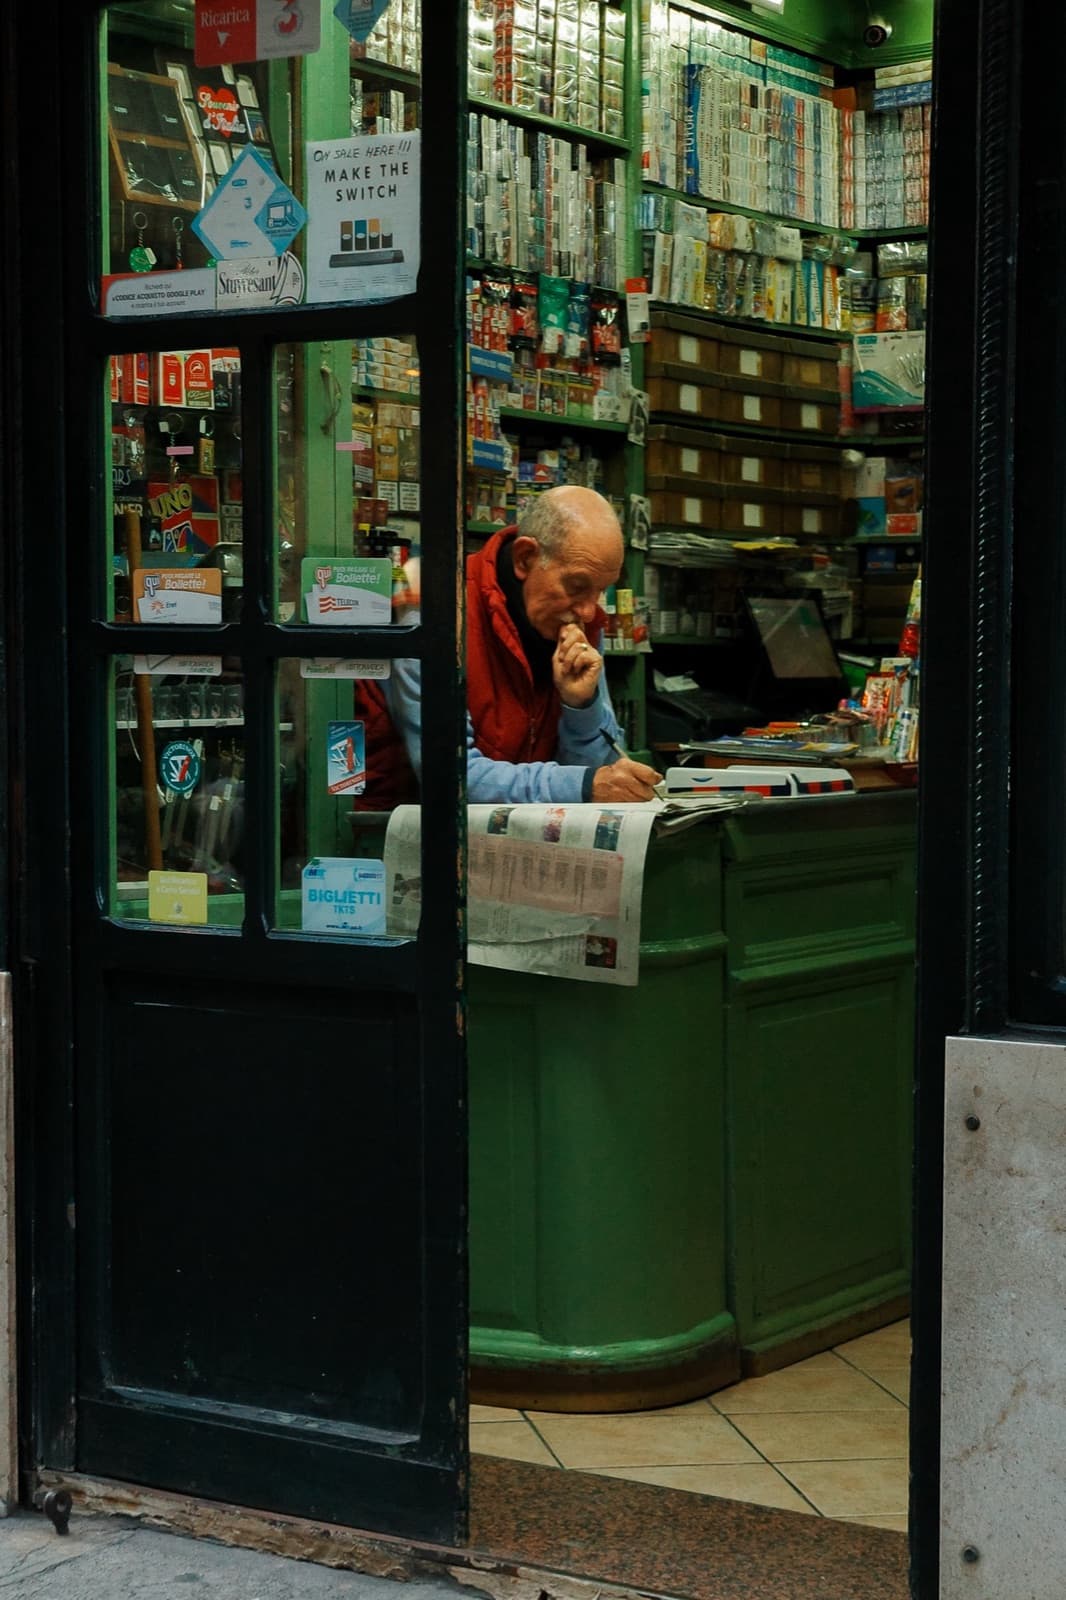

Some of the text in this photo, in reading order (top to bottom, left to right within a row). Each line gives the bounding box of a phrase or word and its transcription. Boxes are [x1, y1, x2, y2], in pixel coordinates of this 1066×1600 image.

[200, 6, 250, 28] Ricarica
[333, 148, 360, 160] SALE
[366, 144, 395, 158] HERE
[325, 161, 409, 183] MAKE THE
[336, 184, 397, 202] SWITCH
[167, 290, 188, 298] GOOGLE
[190, 289, 205, 297] PLAY
[149, 482, 193, 522] UNO
[336, 573, 381, 584] Bollette!
[308, 889, 381, 905] BIGLIETTI
[333, 905, 356, 915] TKTS
